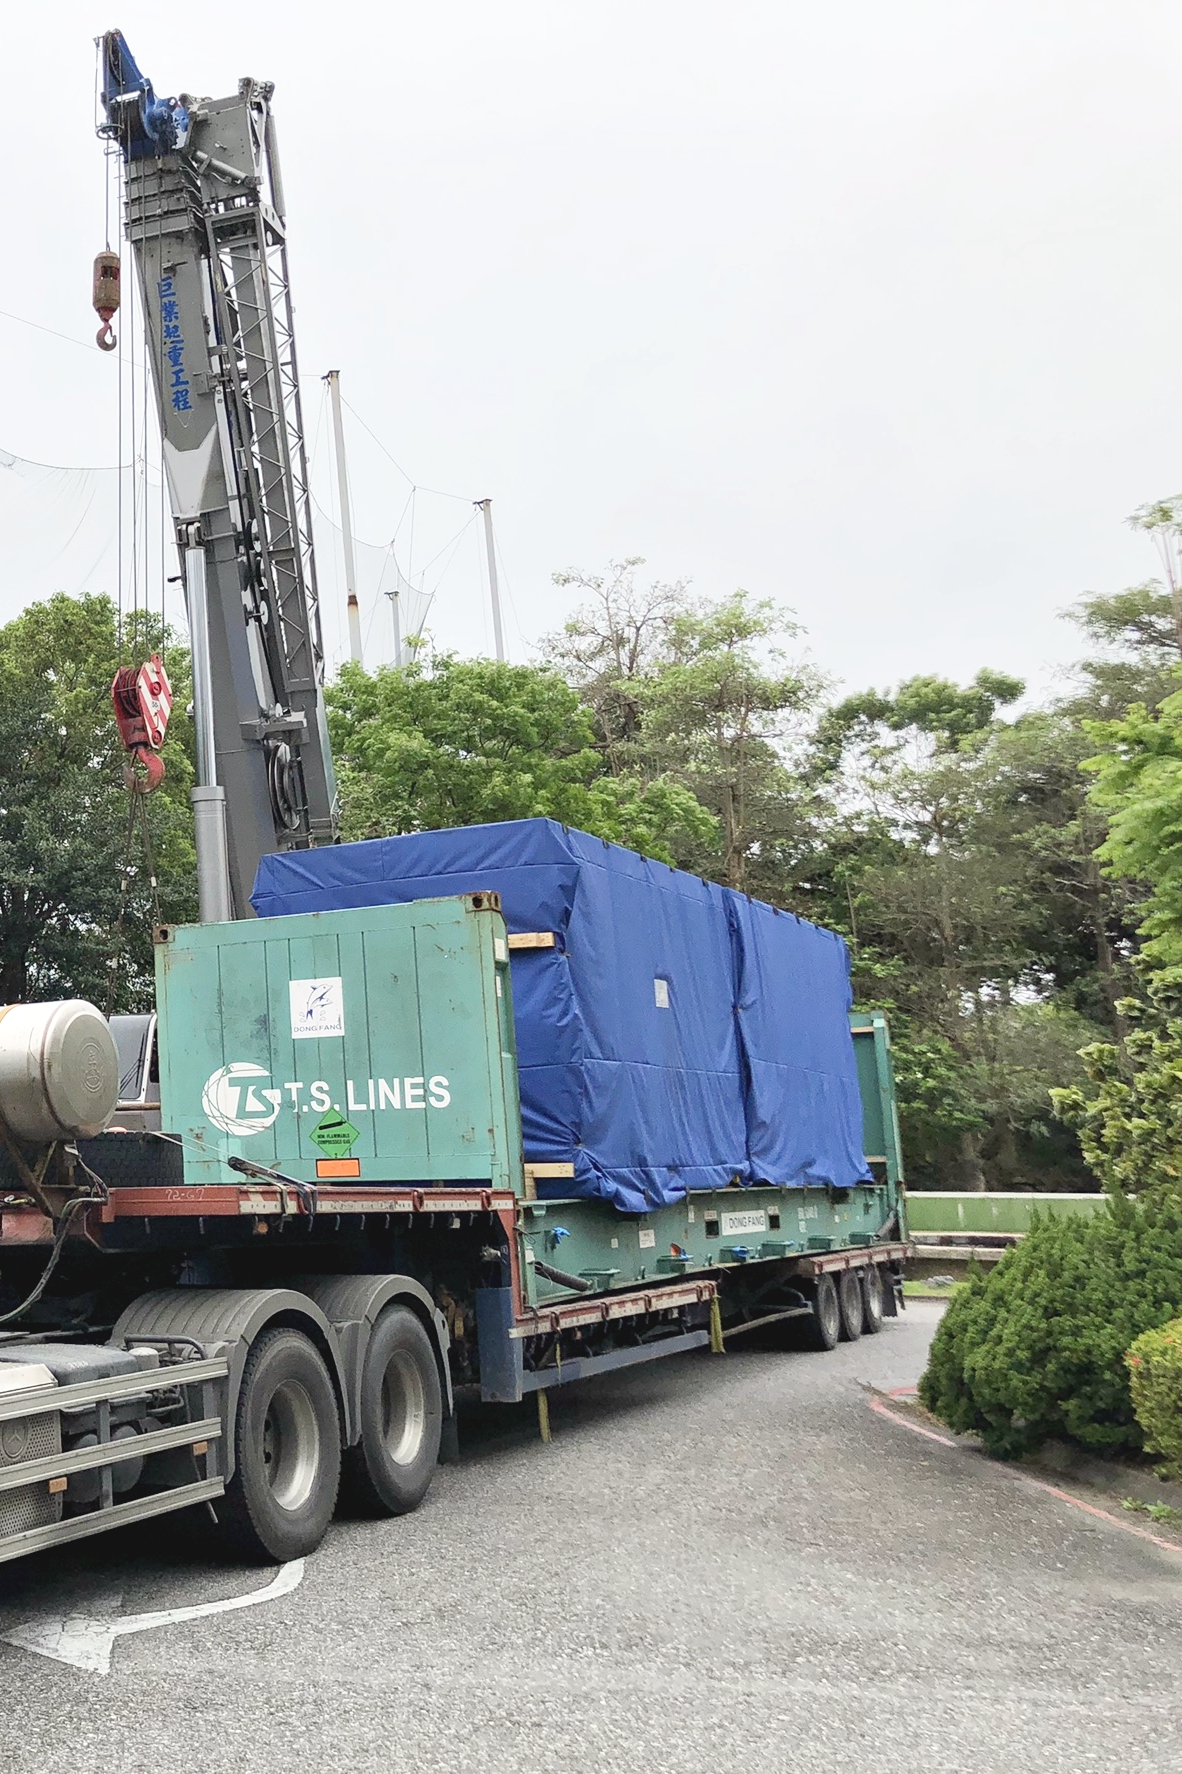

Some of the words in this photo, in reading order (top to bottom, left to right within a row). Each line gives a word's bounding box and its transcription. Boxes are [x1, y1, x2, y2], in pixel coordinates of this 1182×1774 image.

[293, 1025, 318, 1033] DONG
[346, 1075, 452, 1111] LINES
[728, 1216, 748, 1229] DONG
[748, 1215, 765, 1226] FANG
